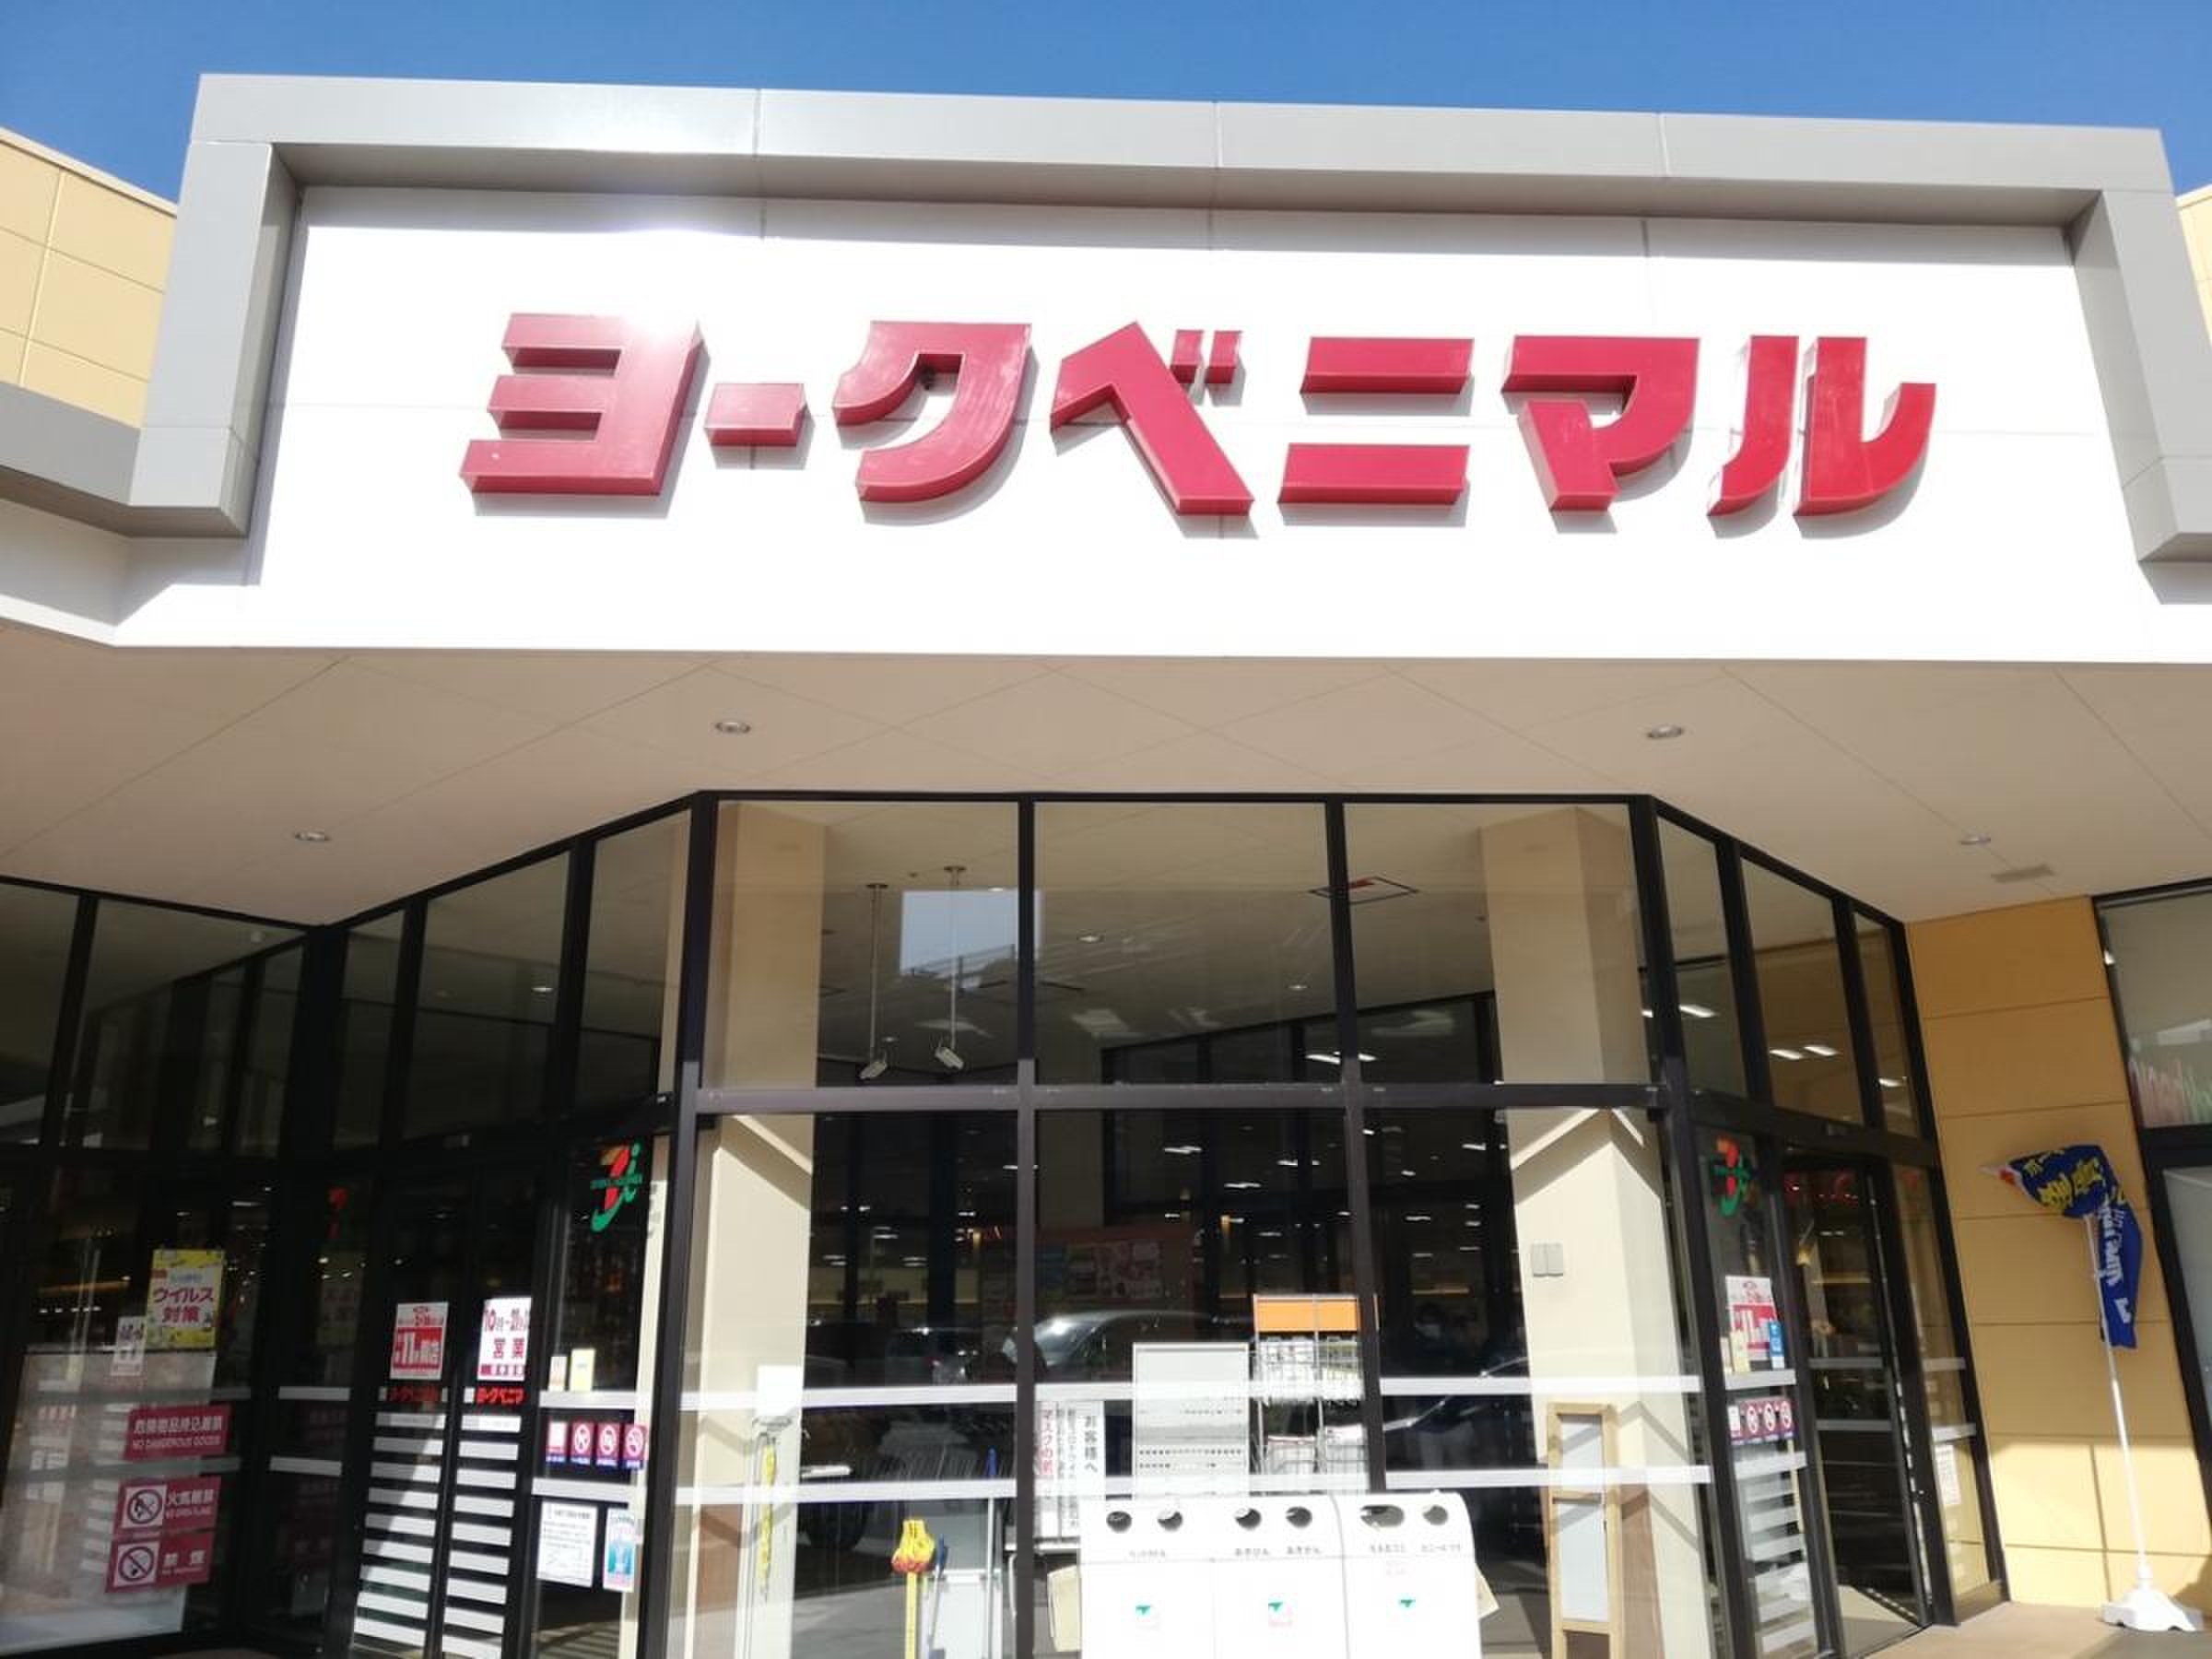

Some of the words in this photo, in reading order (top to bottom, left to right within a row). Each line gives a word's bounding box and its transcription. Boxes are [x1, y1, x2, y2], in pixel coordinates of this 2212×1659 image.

[461, 311, 1936, 517] ヨークベニマル
[153, 1287, 215, 1304] ウイルス
[1083, 1415, 1100, 1474] お客様へ
